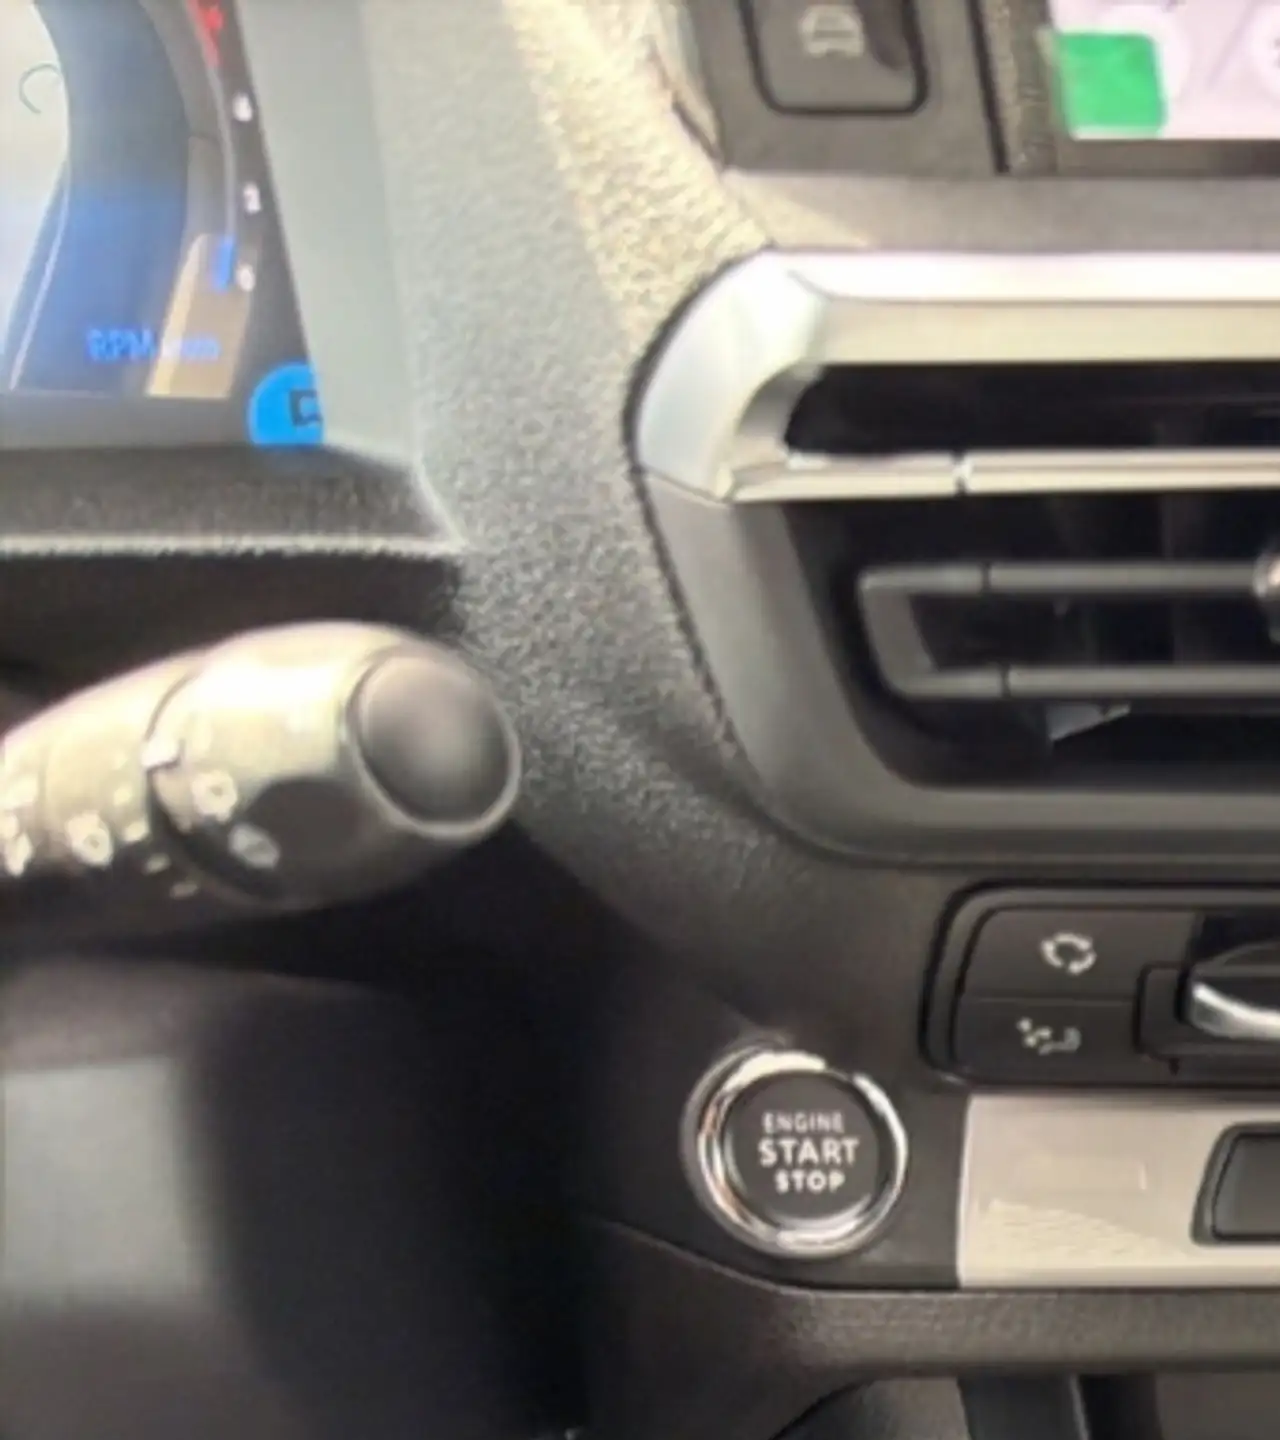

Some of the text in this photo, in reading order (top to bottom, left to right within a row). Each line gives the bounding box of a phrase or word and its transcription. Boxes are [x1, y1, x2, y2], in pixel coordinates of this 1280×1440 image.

[762, 1111, 846, 1134] ENGINE
[758, 1137, 859, 1166] START
[775, 1169, 845, 1194] STOP
